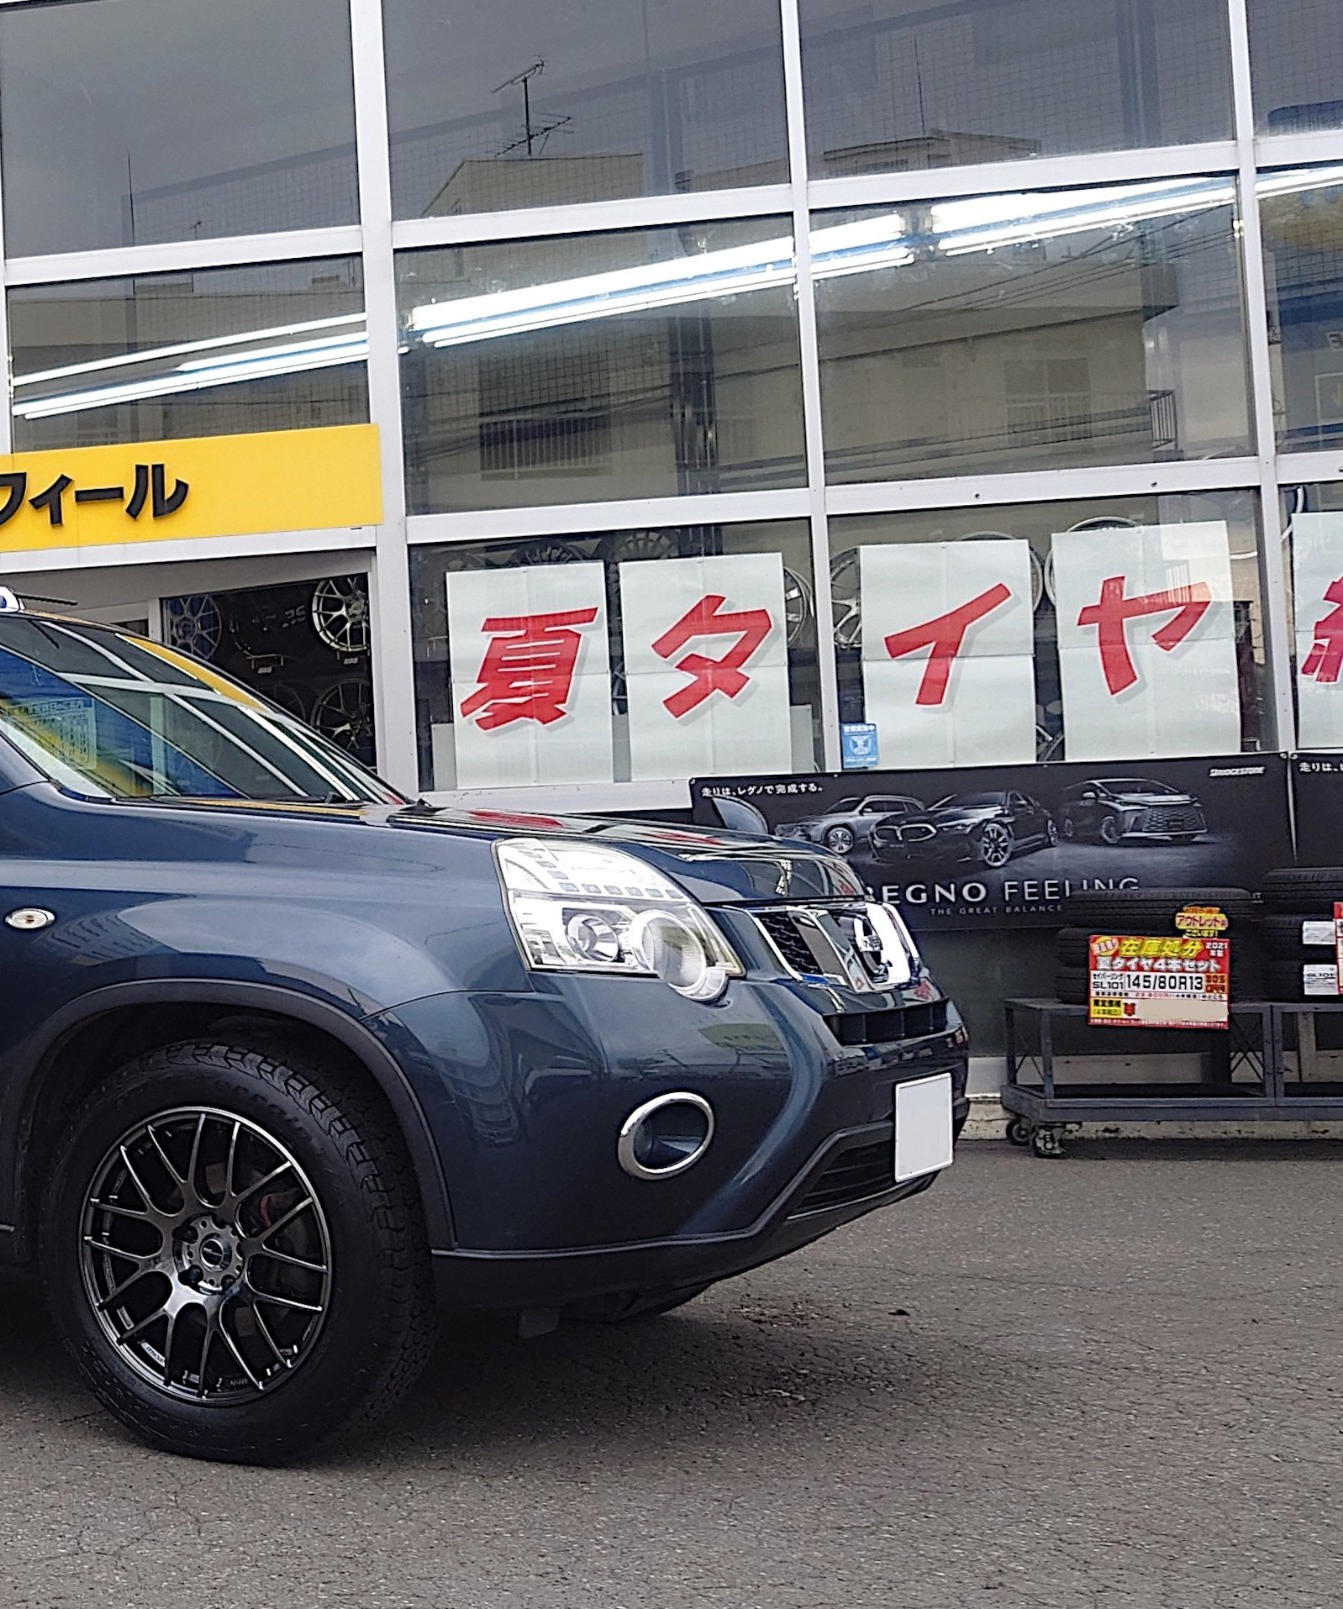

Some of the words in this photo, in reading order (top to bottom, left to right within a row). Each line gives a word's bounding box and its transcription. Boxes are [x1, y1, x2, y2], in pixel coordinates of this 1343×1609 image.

[701, 783, 823, 797] 走りは、レグノで完成する。
[930, 907, 953, 915] THE
[959, 906, 998, 914] GREAT
[1005, 904, 1063, 913] BALANCE
[1120, 938, 1203, 958] 在庫処分
[1092, 981, 1124, 990] SL101
[1126, 974, 1204, 991] 145/80R13
